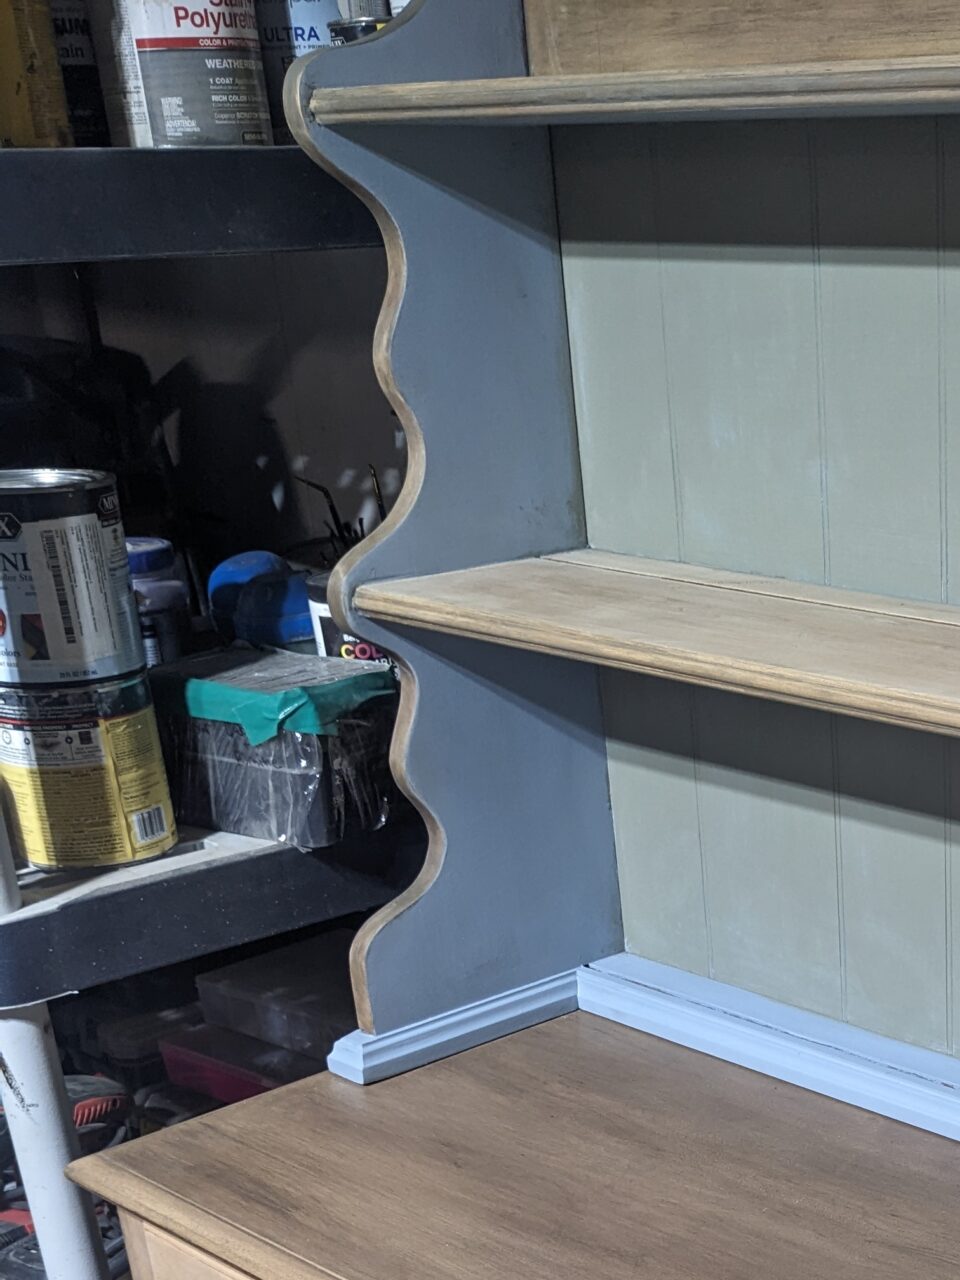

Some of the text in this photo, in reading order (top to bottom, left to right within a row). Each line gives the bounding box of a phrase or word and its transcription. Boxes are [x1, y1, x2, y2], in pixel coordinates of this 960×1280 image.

[264, 26, 321, 42] ULTRA
[199, 38, 221, 47] COLOR
[215, 77, 233, 85] COAT
